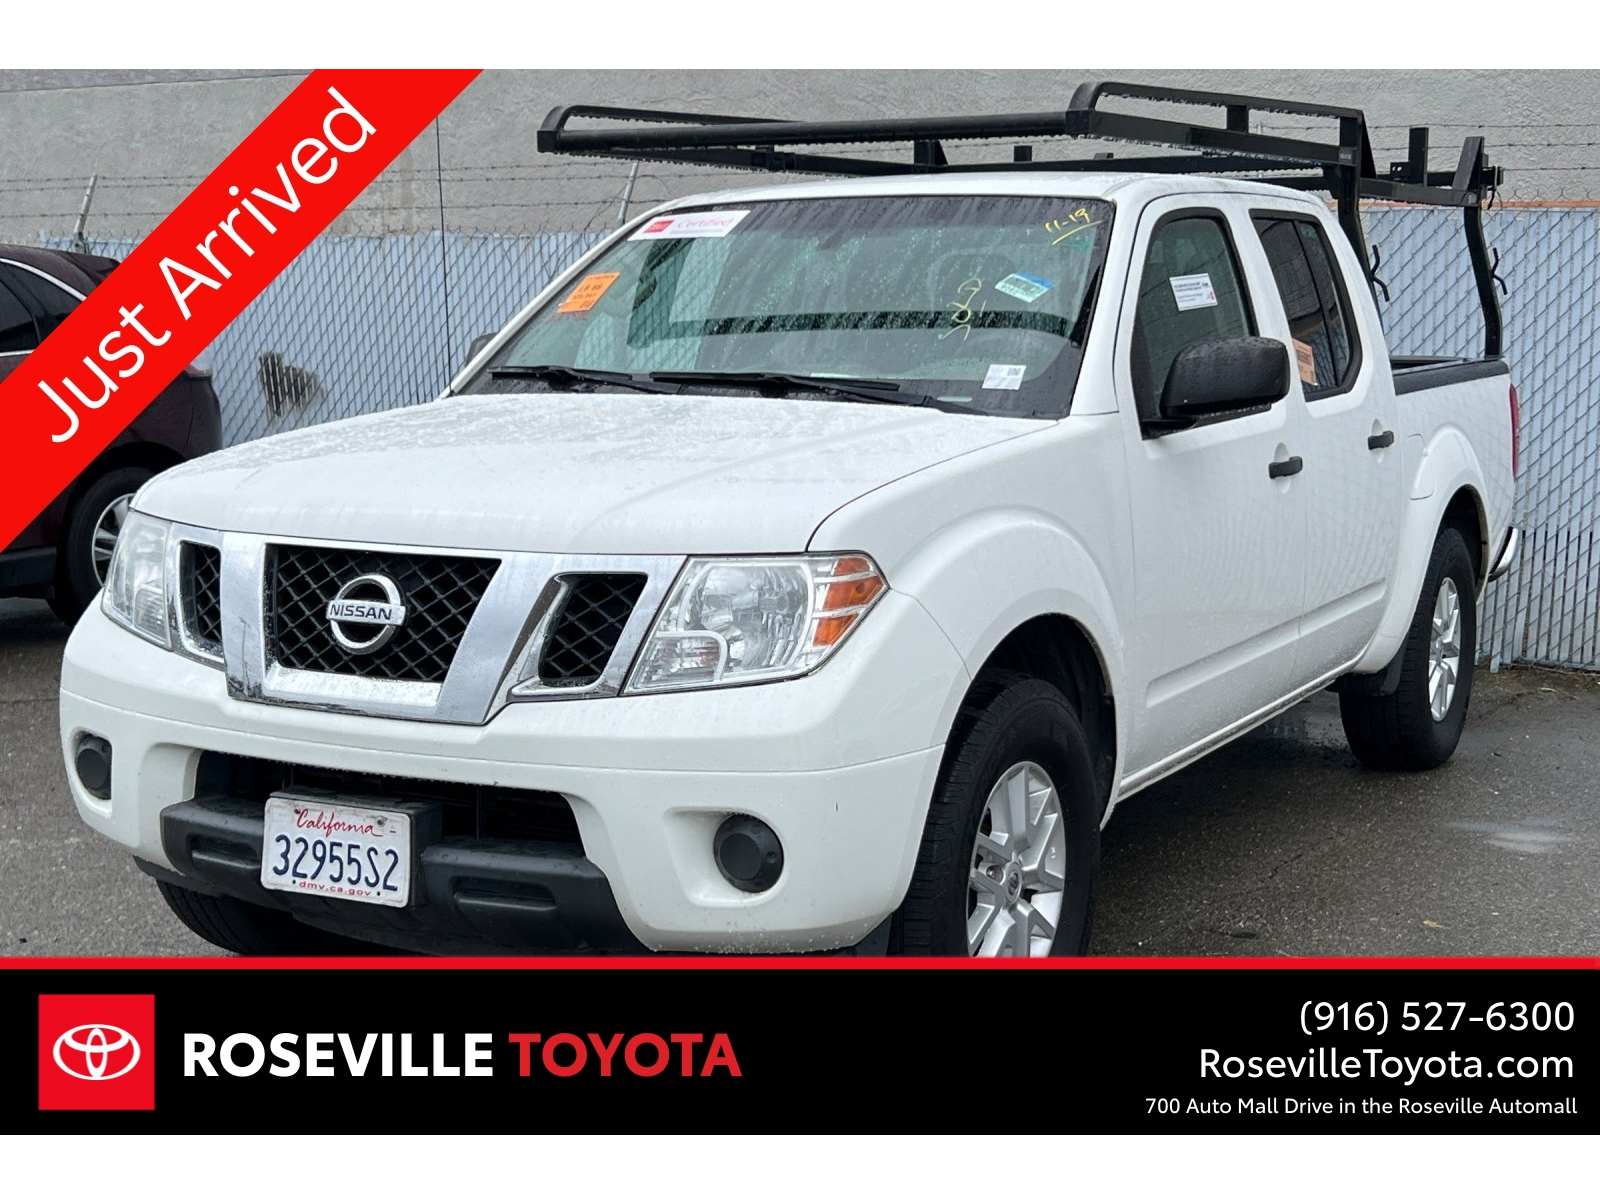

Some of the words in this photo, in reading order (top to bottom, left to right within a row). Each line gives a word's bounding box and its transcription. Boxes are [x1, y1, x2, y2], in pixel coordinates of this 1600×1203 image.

[329, 604, 393, 621] NISSAN
[296, 807, 384, 838] California
[272, 834, 400, 892] 32955S2
[298, 881, 373, 897] dmv.ca.gov
